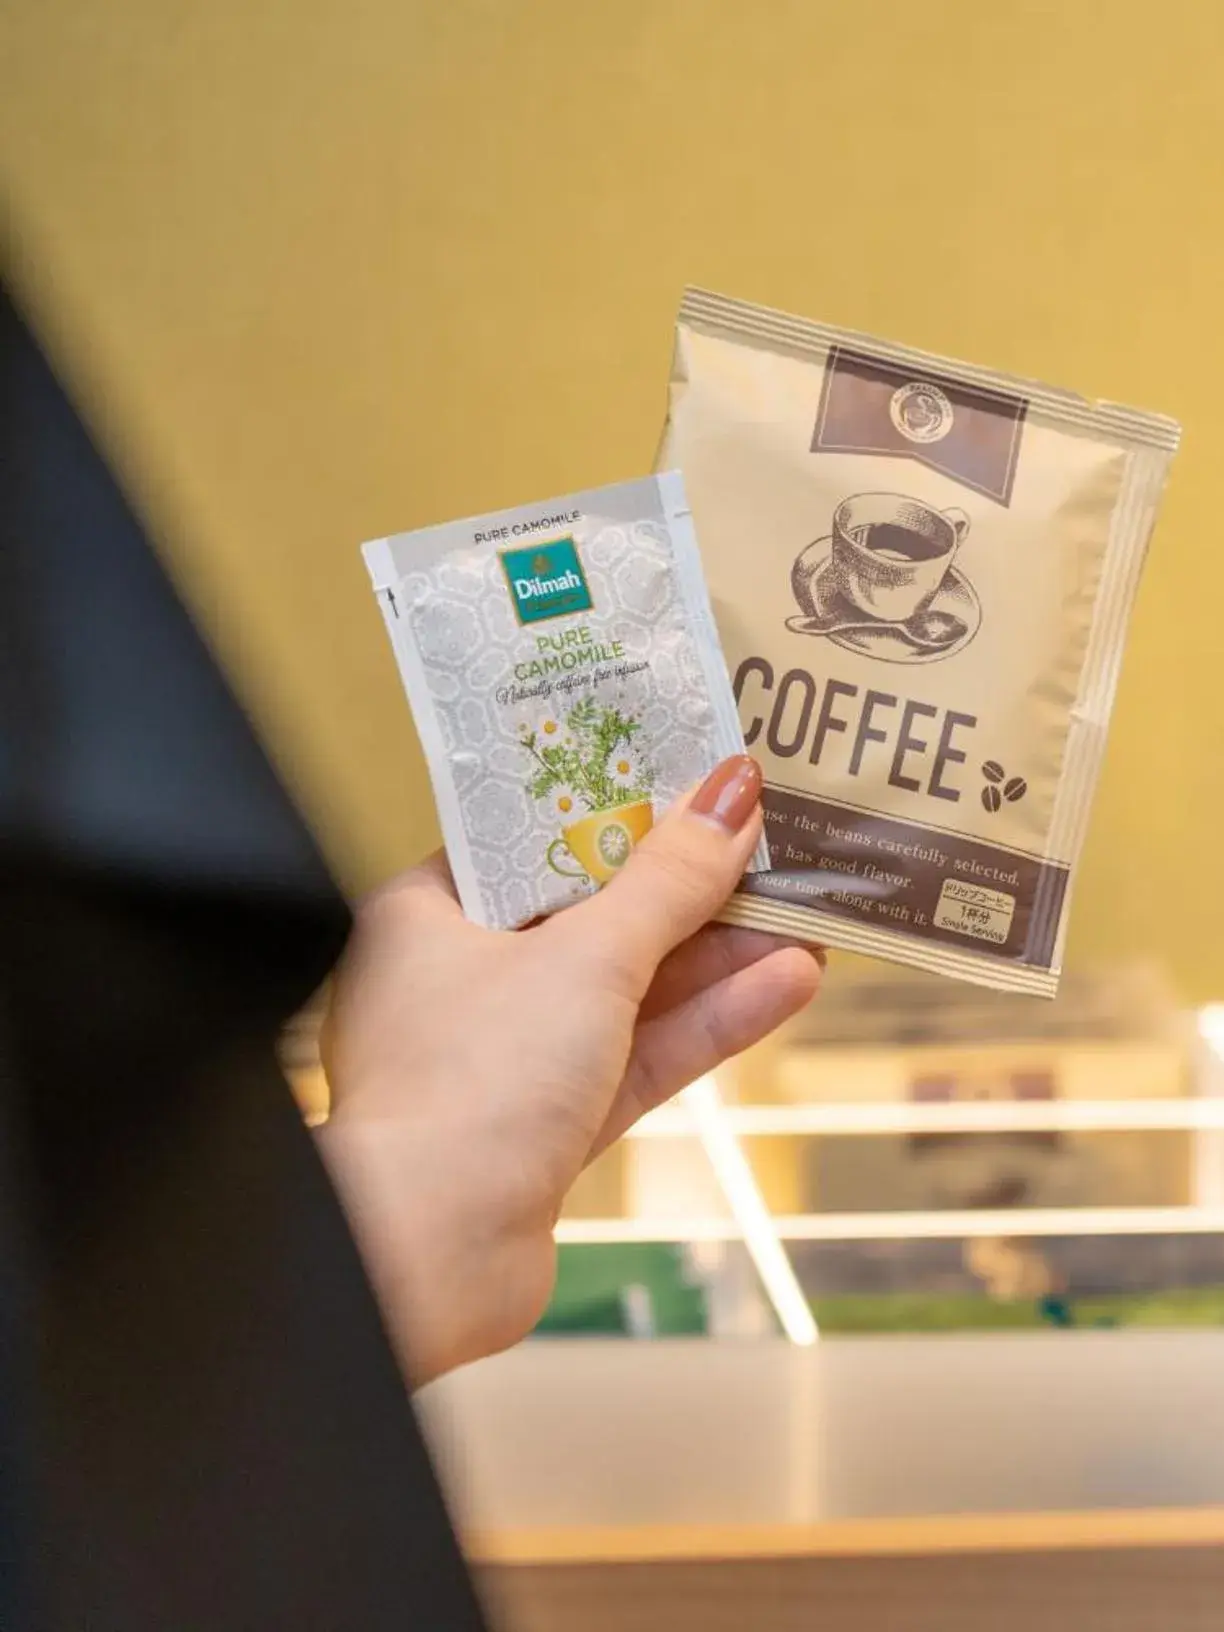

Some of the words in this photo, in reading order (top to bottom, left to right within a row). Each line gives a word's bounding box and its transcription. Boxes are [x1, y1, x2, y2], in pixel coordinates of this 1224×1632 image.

[474, 526, 509, 545] PURE
[511, 510, 583, 537] CAMOMILE
[514, 569, 582, 600] Dilmah
[536, 626, 593, 654] PURE
[514, 640, 626, 681] CAMOMILE
[732, 656, 977, 802] COFFEE
[786, 843, 812, 862] has
[819, 856, 858, 874] good
[794, 815, 819, 832] the
[825, 821, 872, 846] beans
[876, 838, 948, 868] carefully
[953, 857, 1020, 887] selected.
[796, 880, 828, 897] time
[832, 890, 873, 911] along
[878, 901, 910, 920] with
